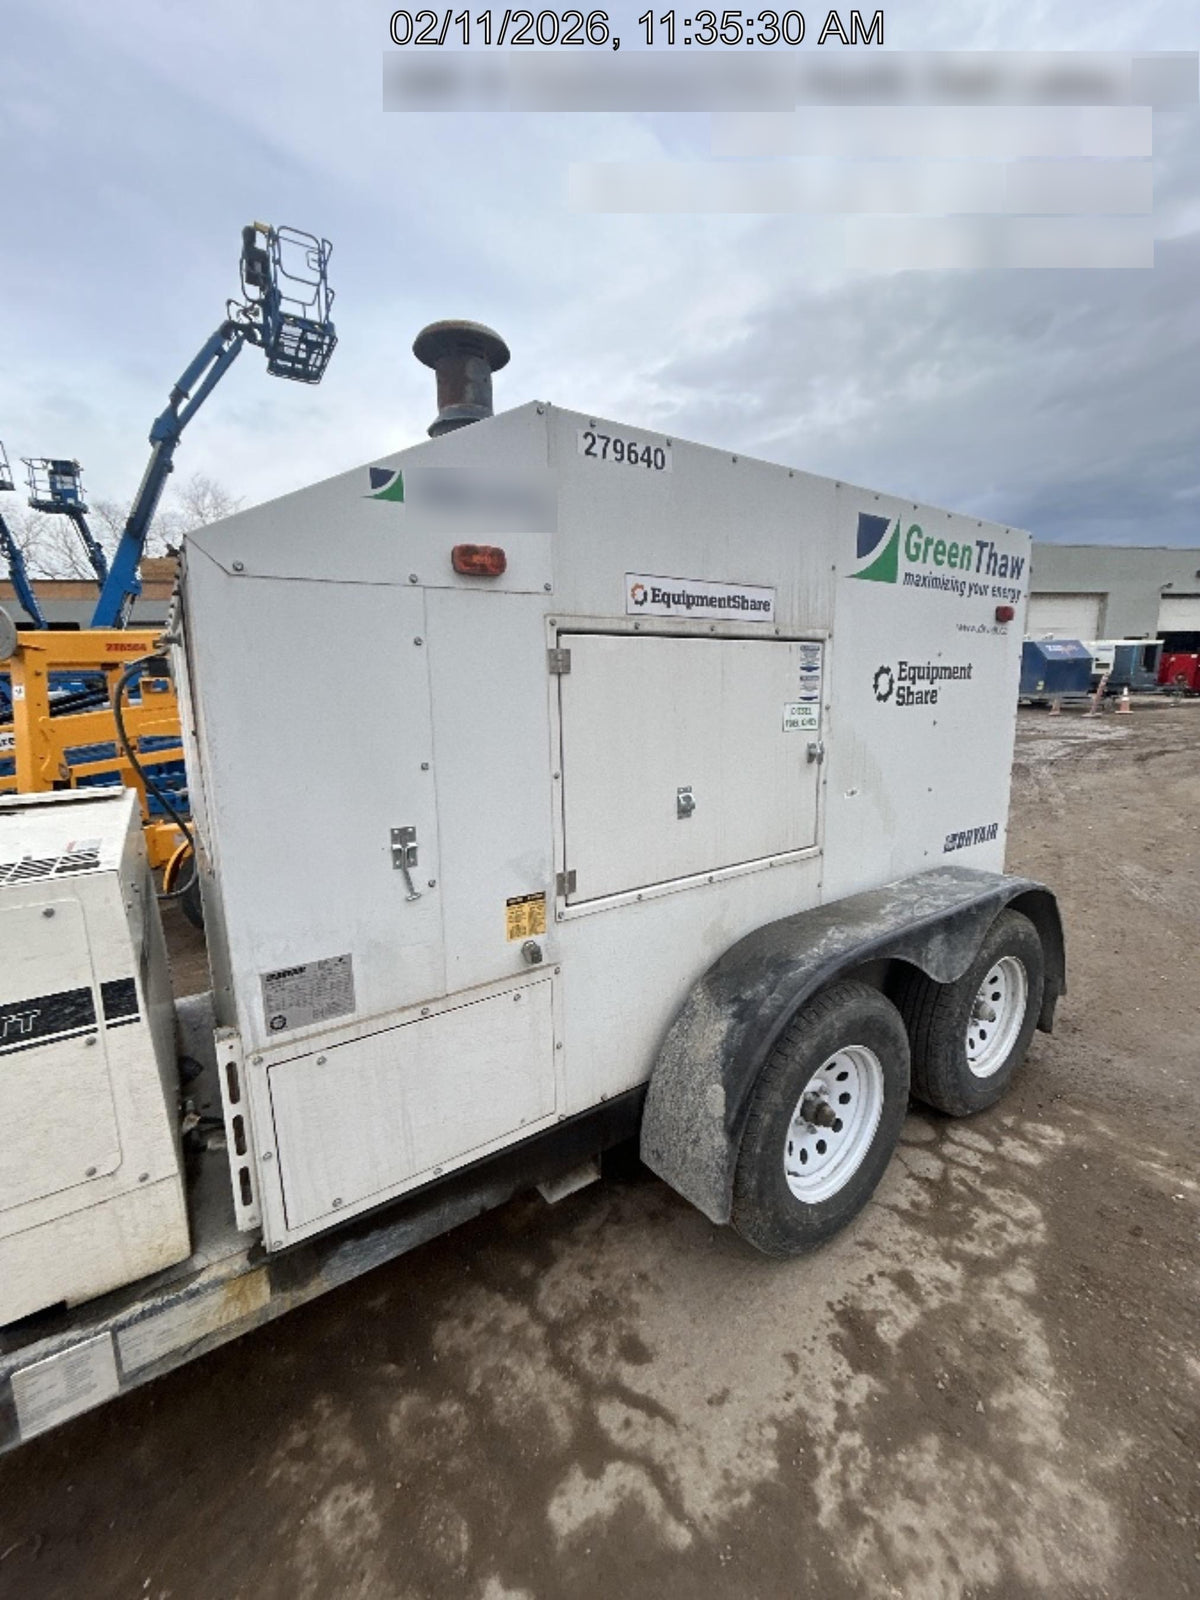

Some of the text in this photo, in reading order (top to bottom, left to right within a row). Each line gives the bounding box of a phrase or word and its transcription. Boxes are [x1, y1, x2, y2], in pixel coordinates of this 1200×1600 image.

[583, 431, 666, 471] 279640
[650, 586, 771, 612] EquipmentShare
[903, 571, 1022, 604] maximizing your energy
[897, 661, 973, 685] Equipment
[895, 686, 938, 707] Share
